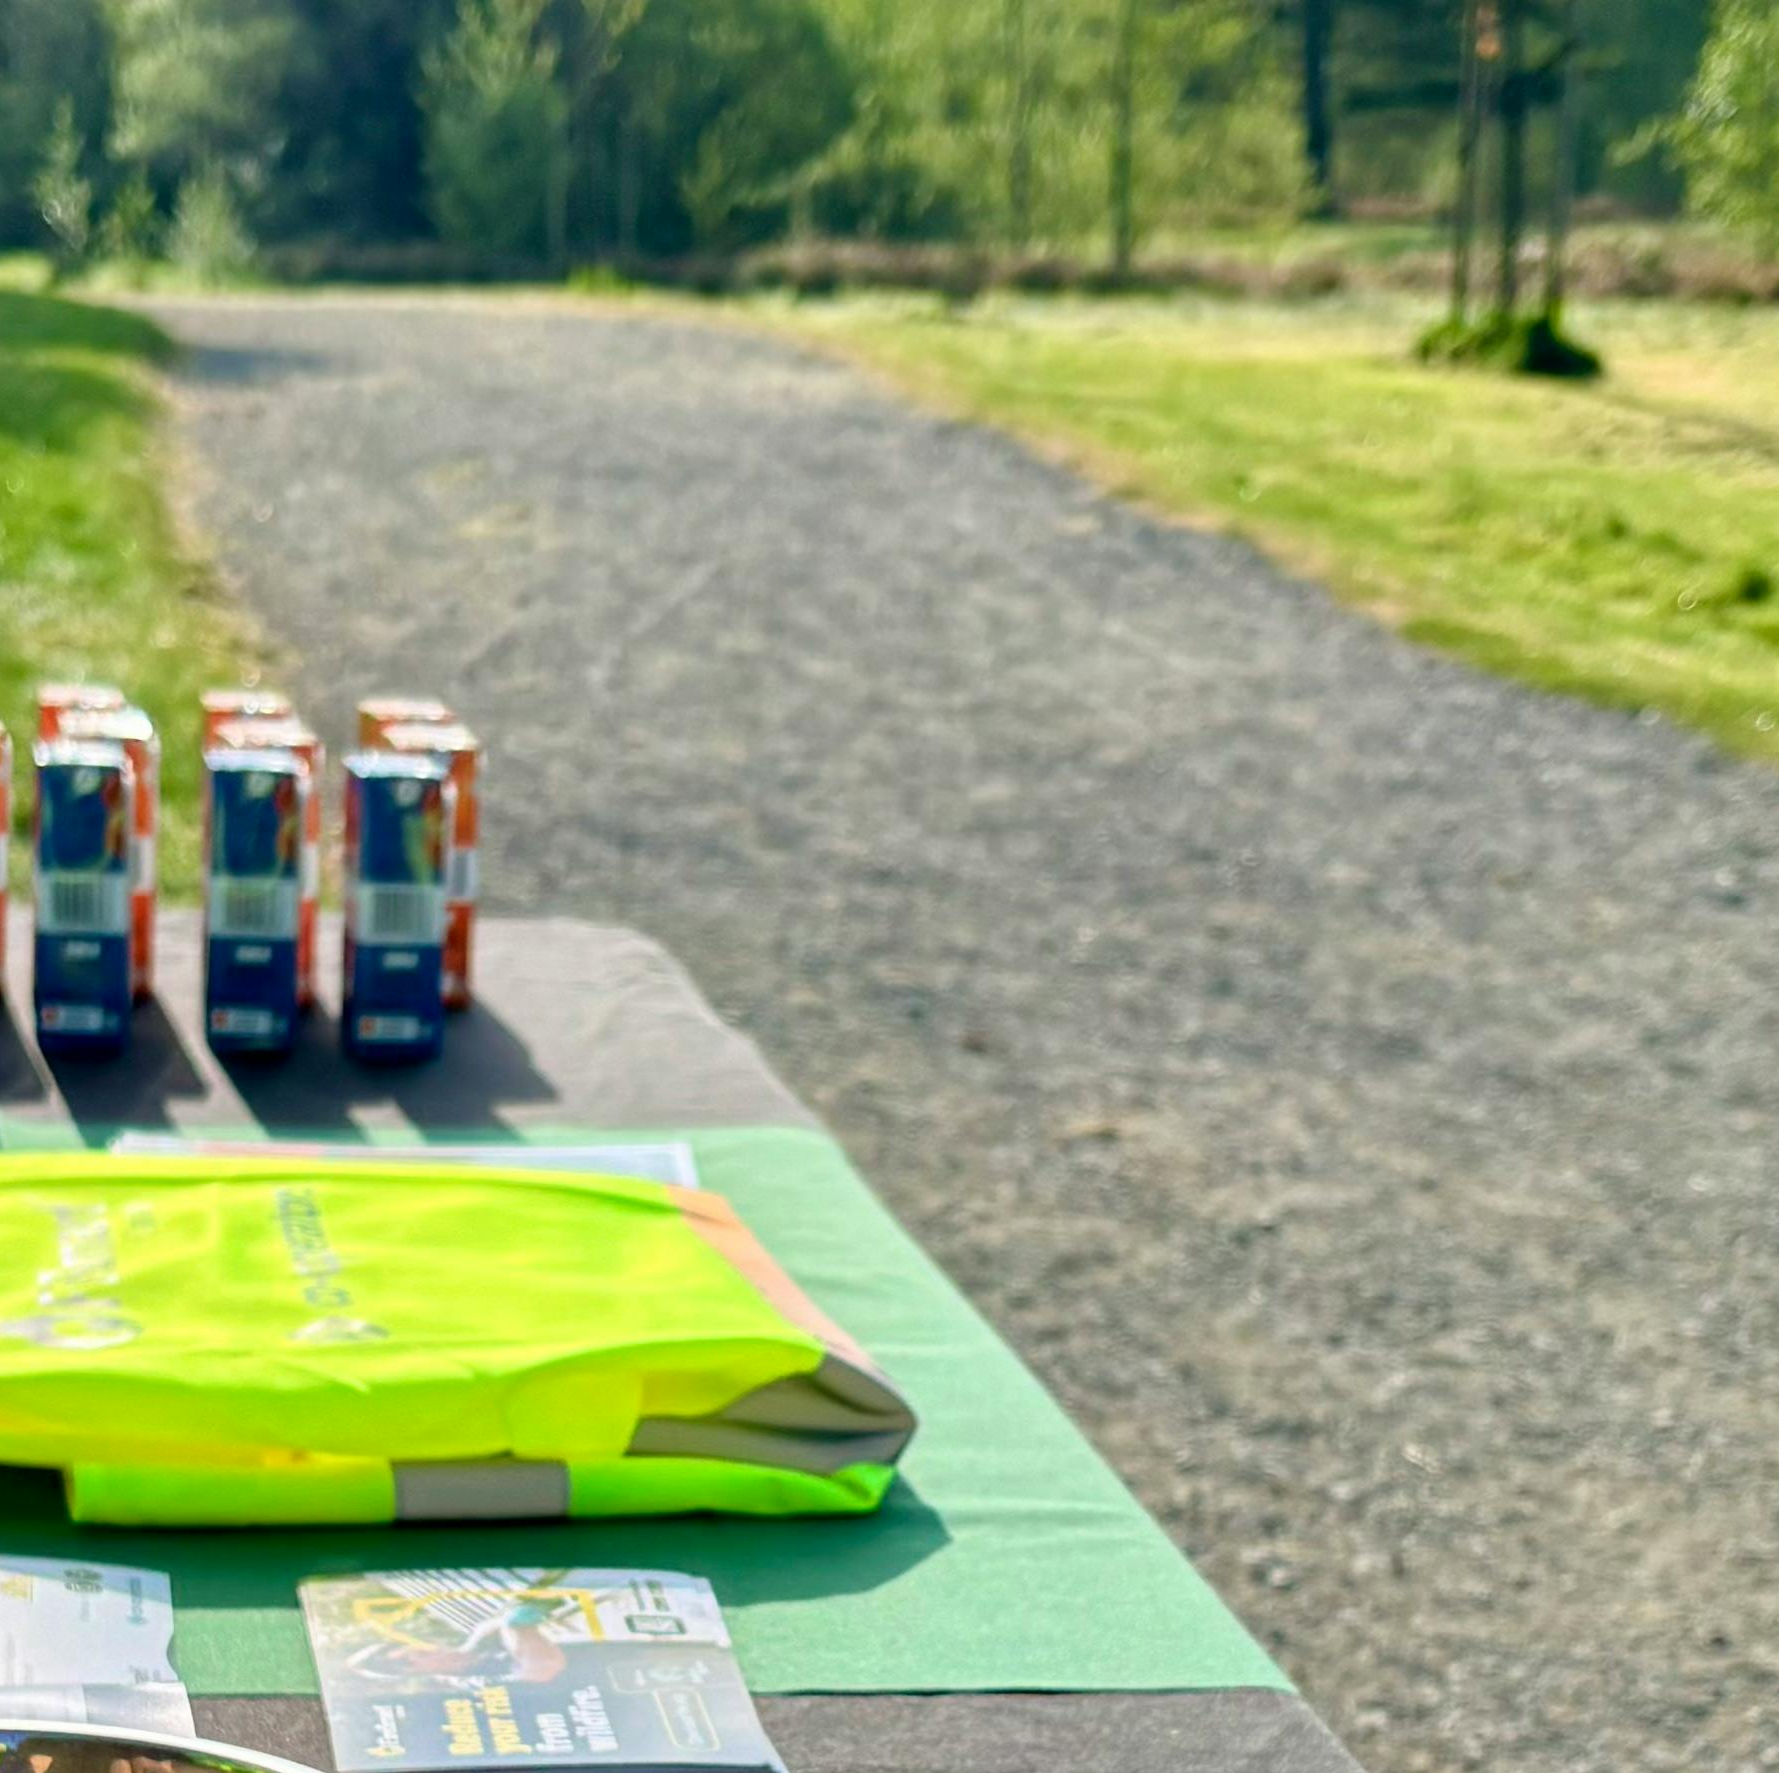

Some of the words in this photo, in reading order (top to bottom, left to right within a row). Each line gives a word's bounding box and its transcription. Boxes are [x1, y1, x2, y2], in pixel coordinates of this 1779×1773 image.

[442, 1699, 484, 1754] Reduce
[488, 1718, 533, 1755] your
[535, 1713, 574, 1752] from
